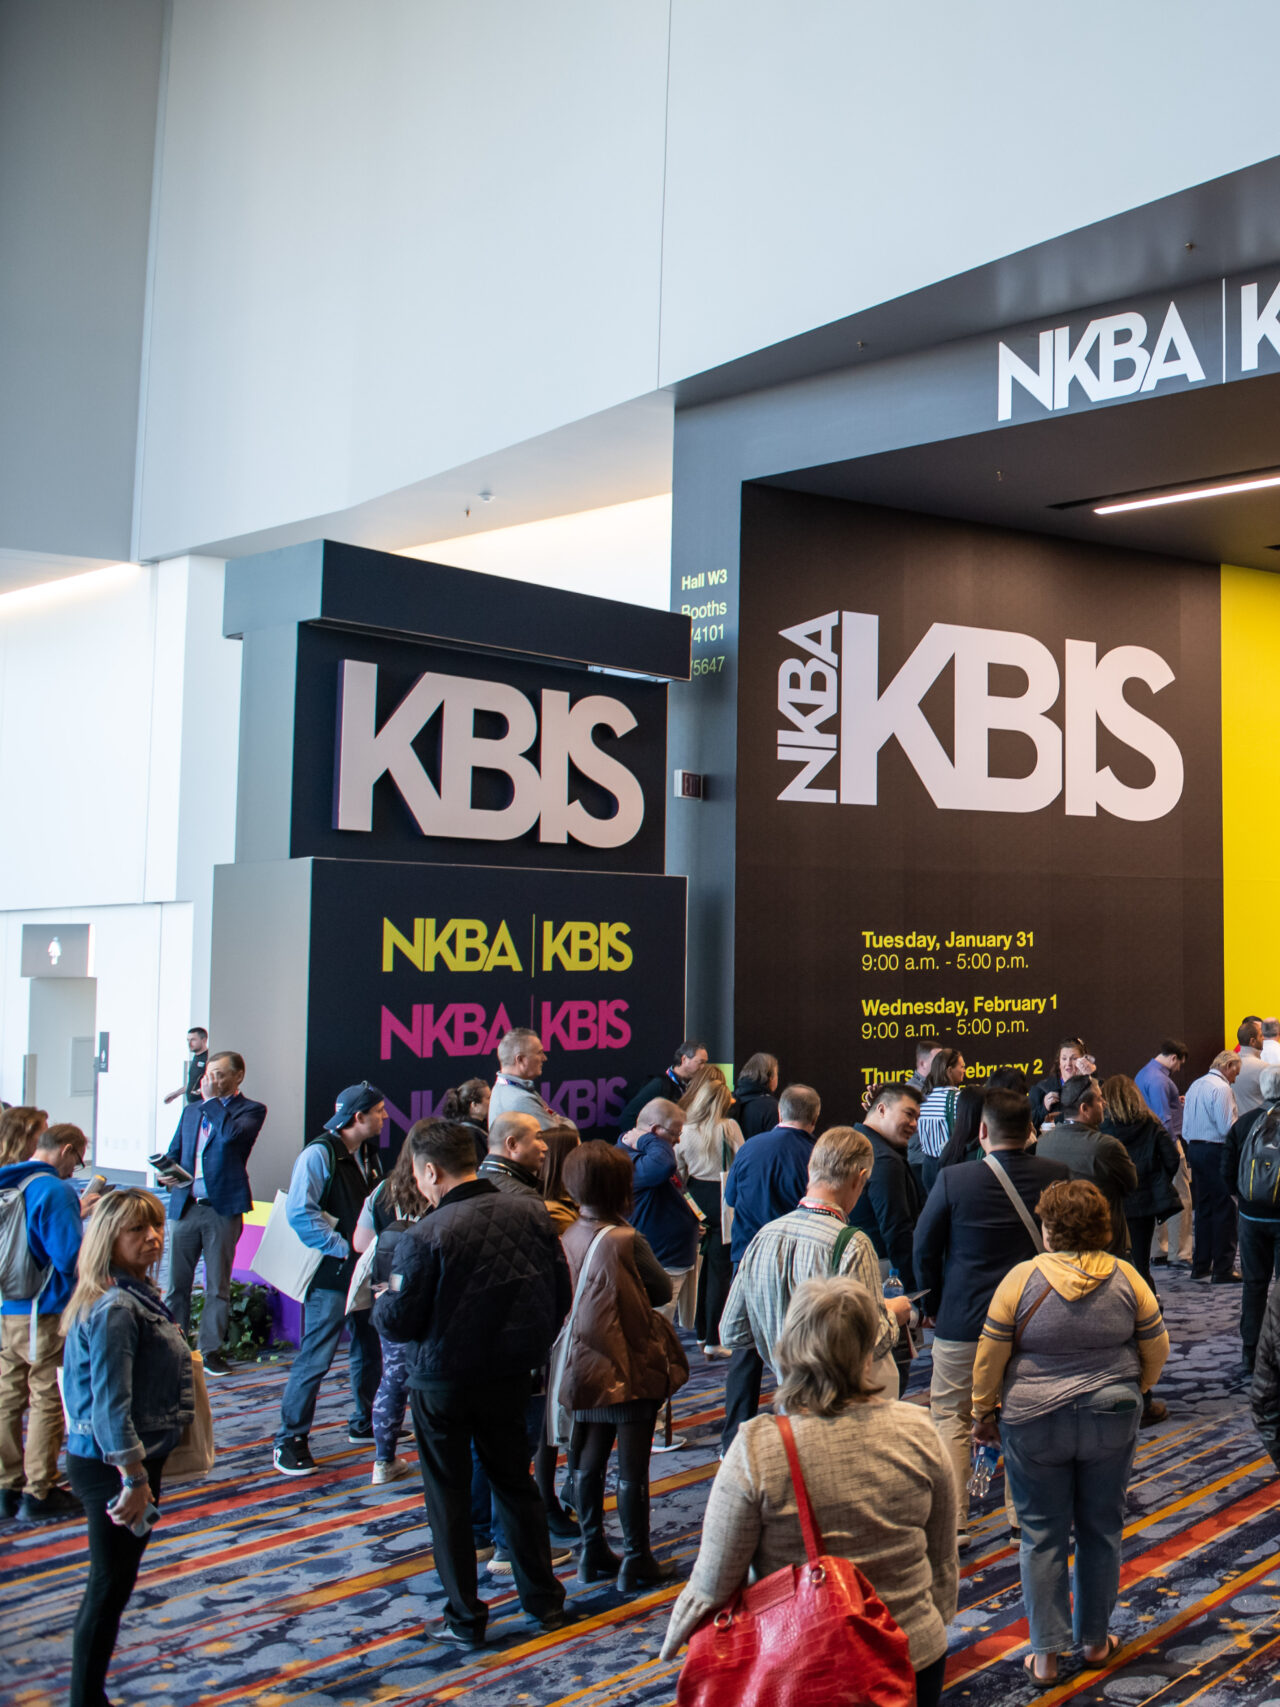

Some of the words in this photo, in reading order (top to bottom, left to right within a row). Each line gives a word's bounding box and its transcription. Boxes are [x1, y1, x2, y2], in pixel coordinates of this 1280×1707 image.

[998, 300, 1206, 422] NKBA
[681, 572, 705, 591] Hall
[707, 568, 728, 587] W3
[681, 601, 727, 620] Booths
[691, 623, 725, 643] 4101
[690, 656, 726, 676] 5647
[777, 610, 839, 804] NKBA
[839, 610, 1184, 822] KBIS
[332, 658, 645, 849] KBIS
[382, 916, 523, 973] NKBA
[542, 920, 633, 972] KBIS
[861, 931, 941, 951] Tuesday,
[945, 931, 1012, 951] January
[1016, 931, 1034, 947] 31
[861, 954, 899, 971] 9:00
[905, 956, 940, 970] a.m.
[956, 953, 991, 969] 5:00
[996, 955, 1029, 972] p.m.
[861, 997, 969, 1017] Wednesday,
[973, 995, 1047, 1014] February
[1050, 994, 1058, 1009] 1
[380, 1002, 513, 1060] NKBA
[541, 999, 632, 1053] KBIS
[861, 1021, 899, 1039] 9:00
[905, 1023, 940, 1038] a.m.
[956, 1018, 991, 1035] 5:00
[996, 1019, 1029, 1037] p.m.
[861, 1067, 914, 1085] Thurs
[1033, 1058, 1044, 1075] 2
